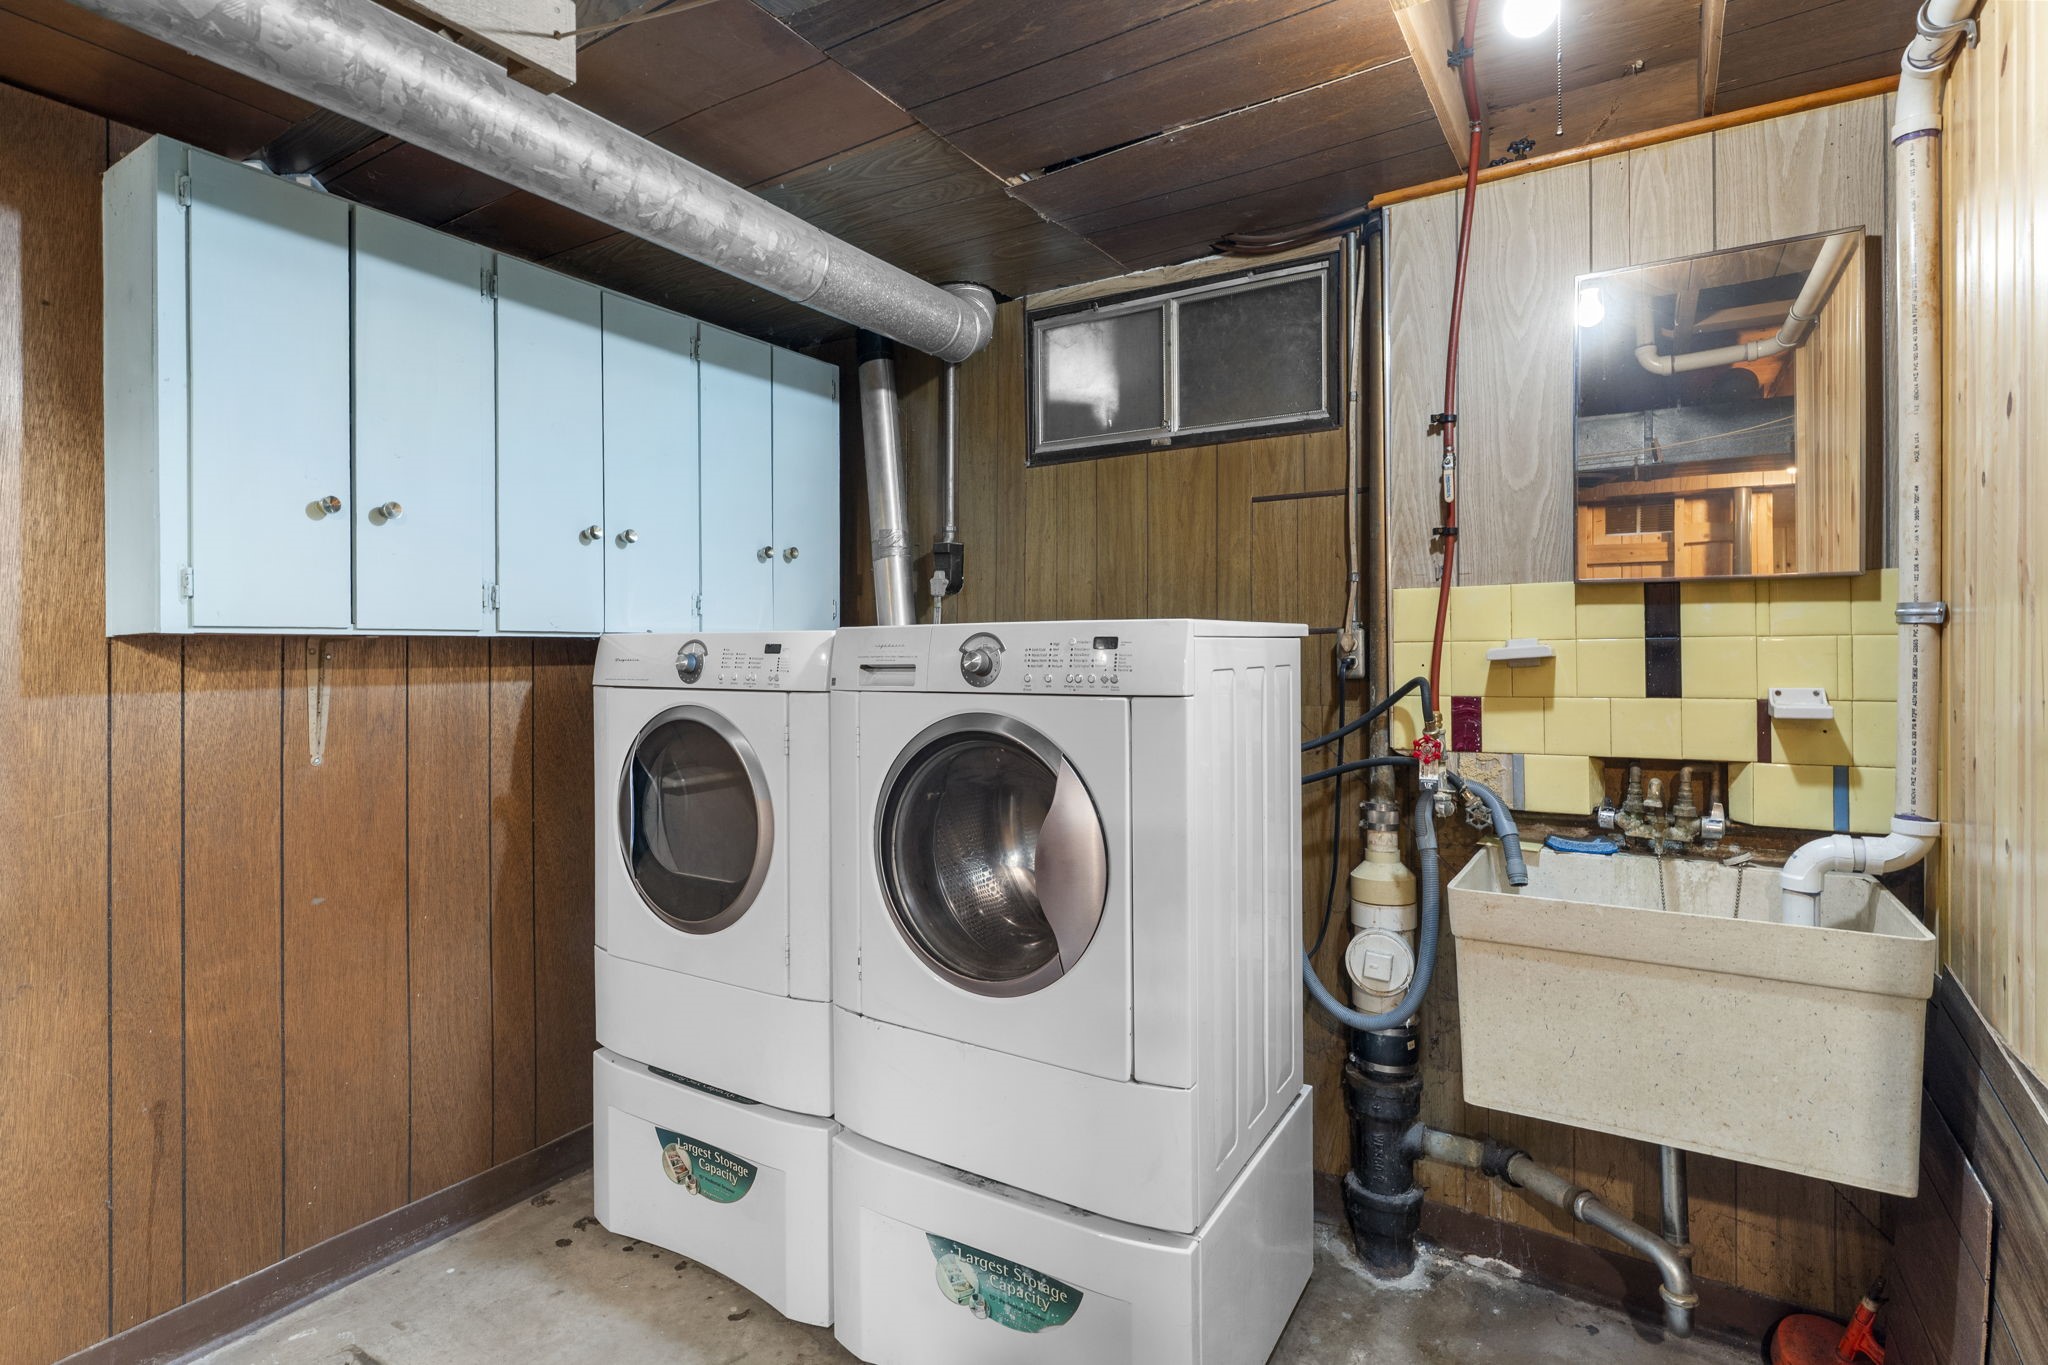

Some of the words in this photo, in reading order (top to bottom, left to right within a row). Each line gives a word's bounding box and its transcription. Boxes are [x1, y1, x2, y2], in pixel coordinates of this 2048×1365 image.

[677, 1137, 712, 1160] Largest
[714, 1151, 749, 1177] Storage
[699, 1158, 738, 1186] Capacity
[956, 1247, 1009, 1277] Largest
[1013, 1267, 1069, 1304] Storage
[989, 1274, 1051, 1312] Capacity
